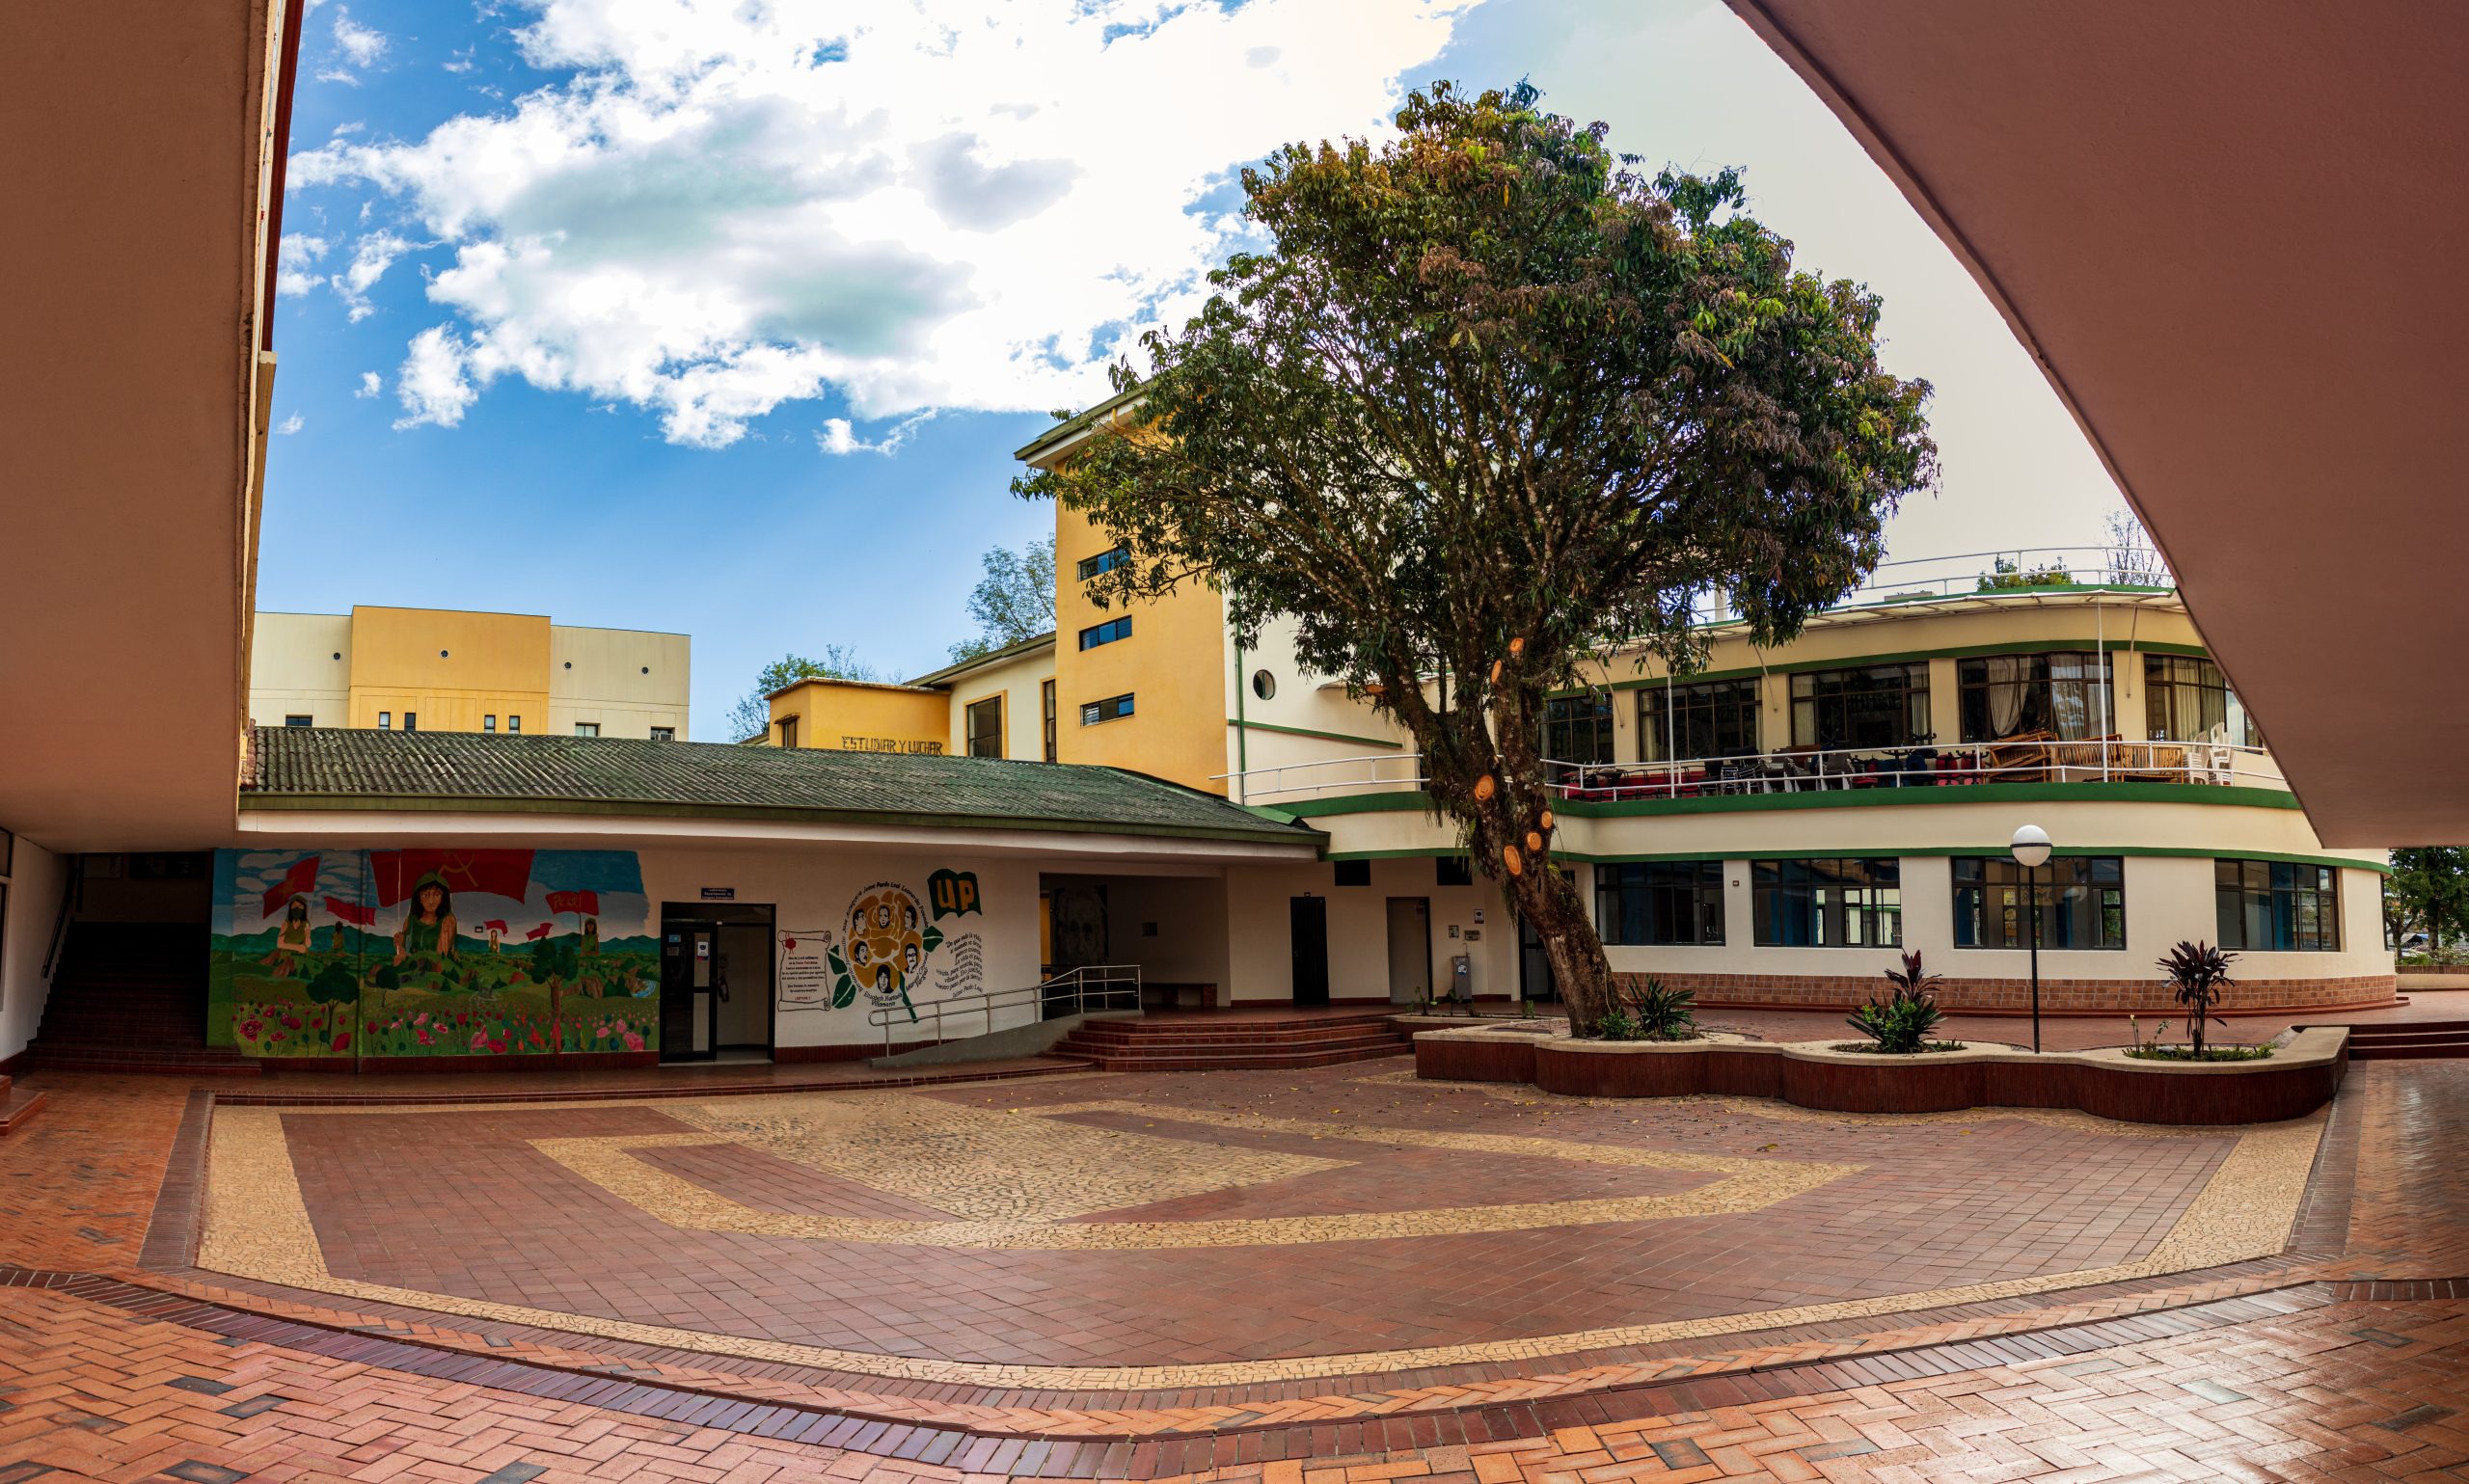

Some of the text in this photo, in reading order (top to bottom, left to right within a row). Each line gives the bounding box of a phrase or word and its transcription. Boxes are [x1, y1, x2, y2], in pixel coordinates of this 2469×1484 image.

[842, 736, 943, 756] ESTUDIAR Y LUCHAR
[901, 885, 920, 906] Leonardo
[936, 878, 974, 910] UP
